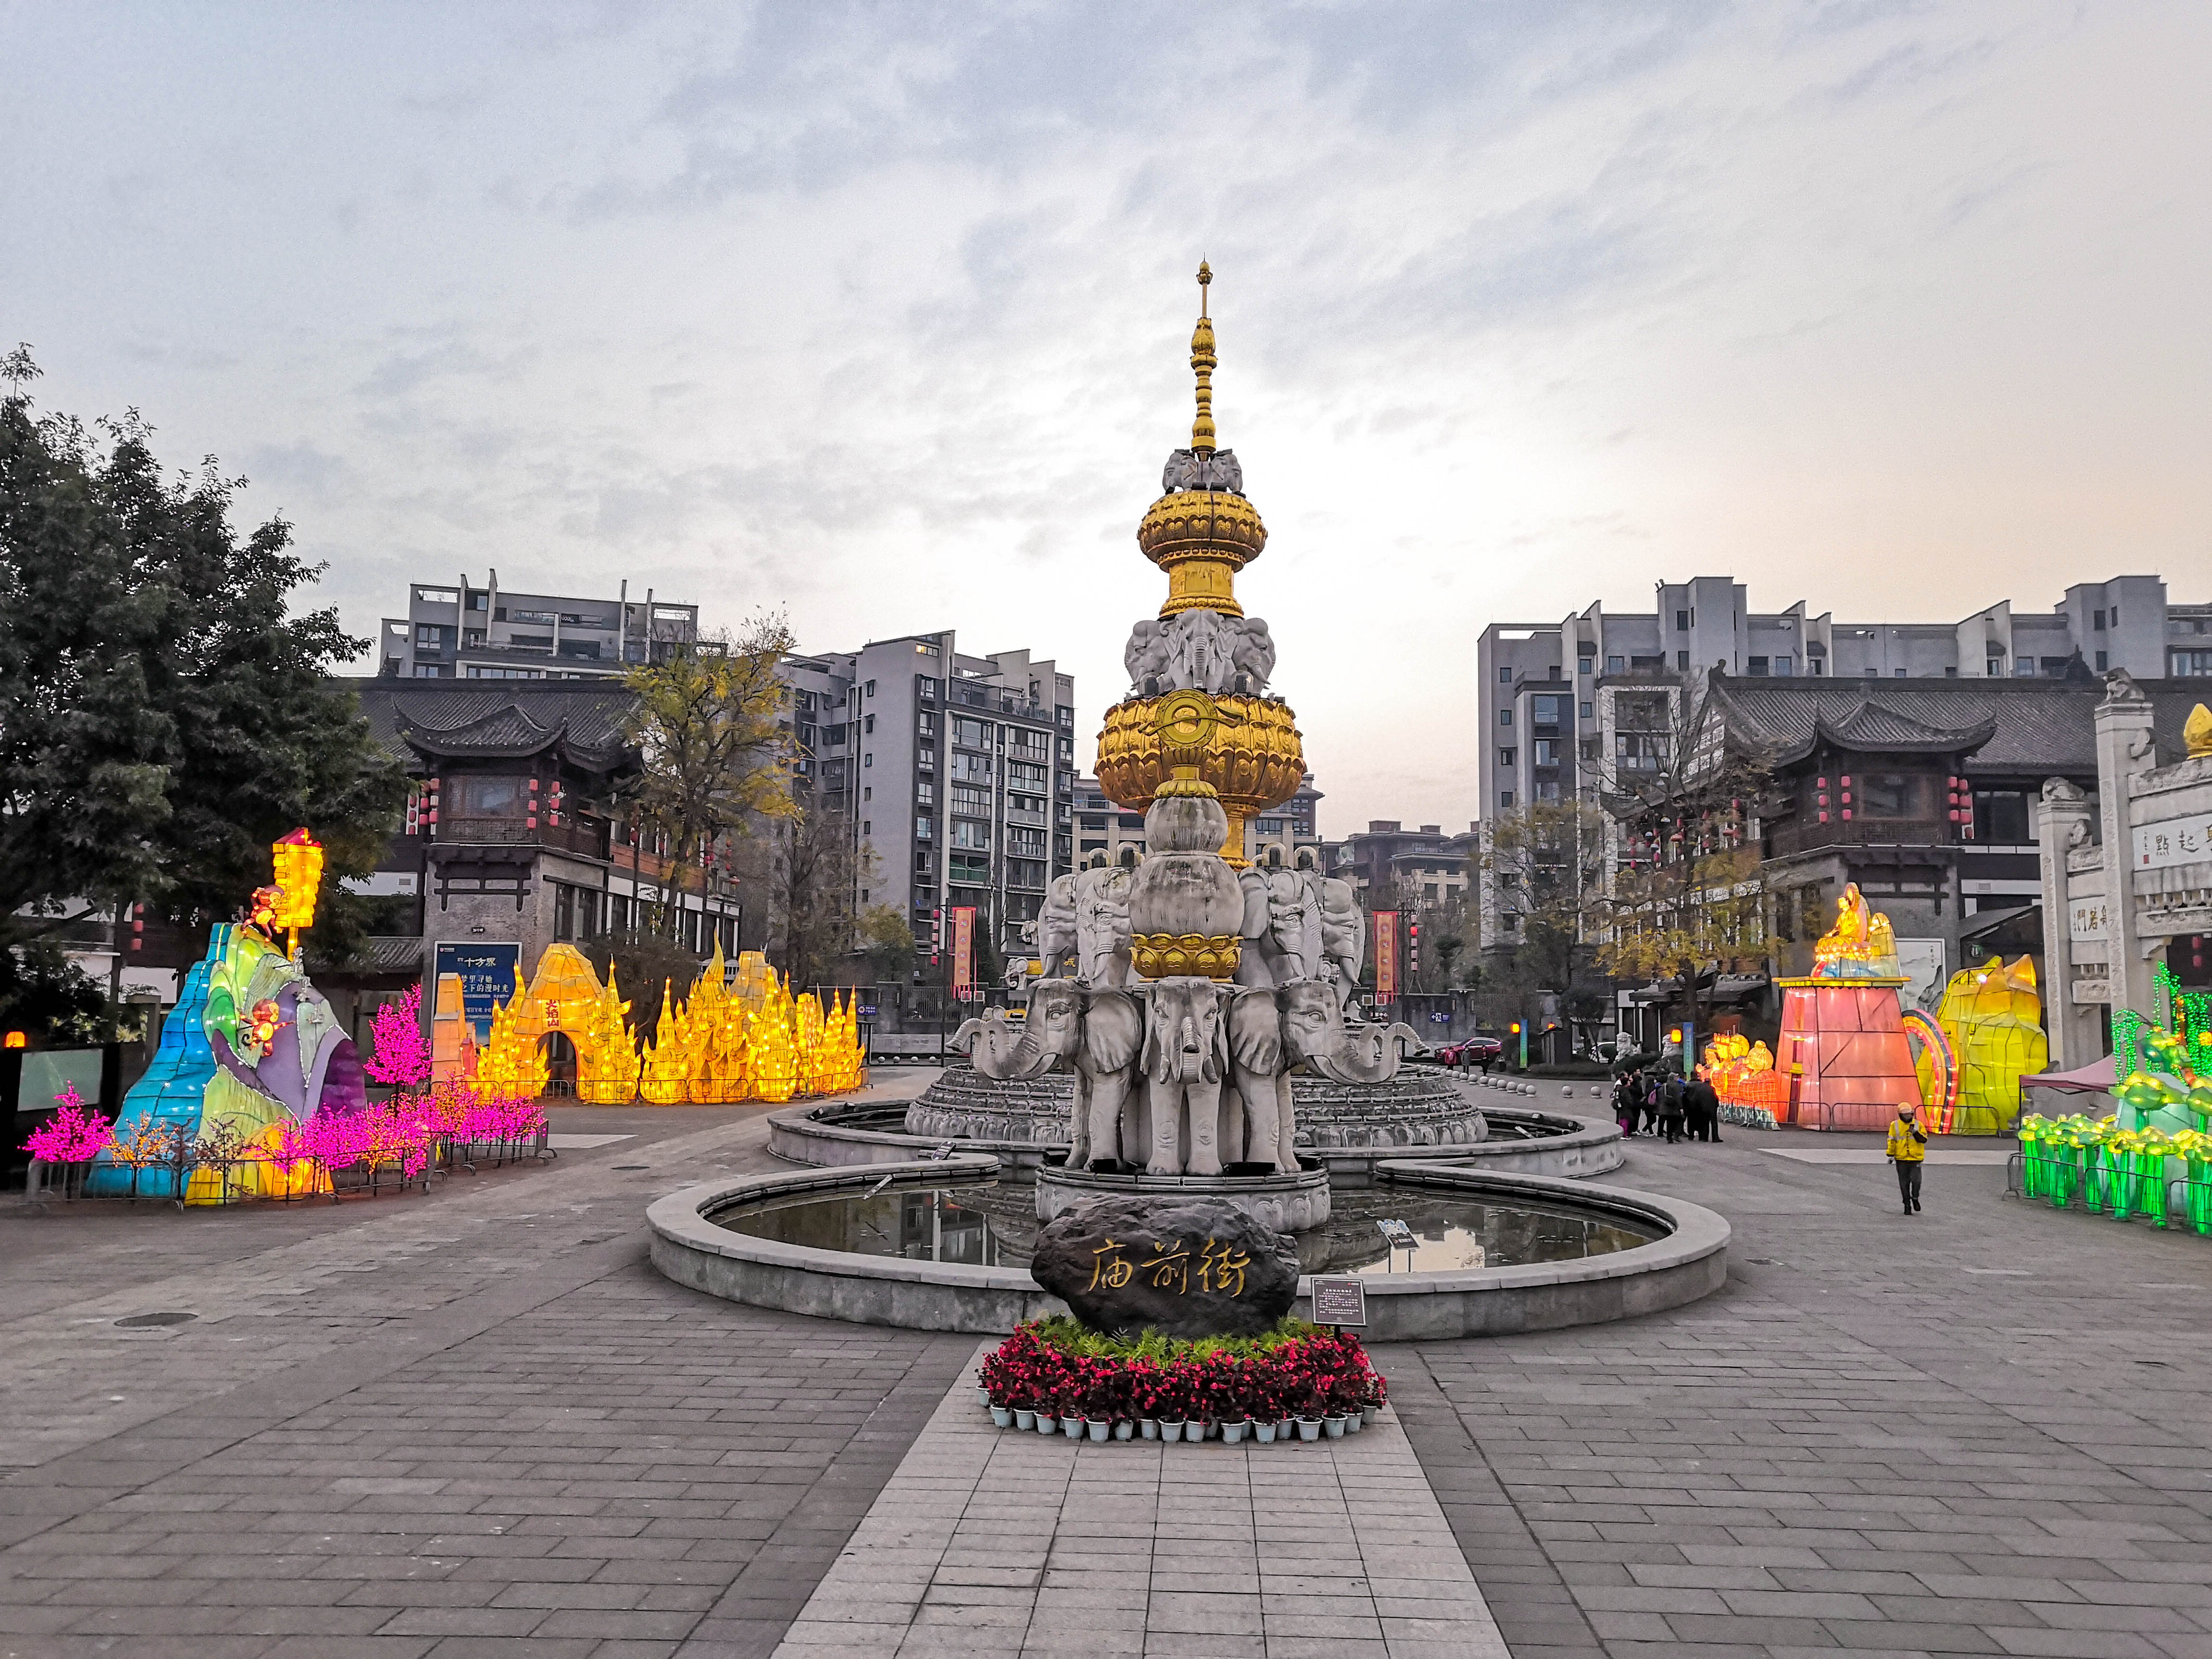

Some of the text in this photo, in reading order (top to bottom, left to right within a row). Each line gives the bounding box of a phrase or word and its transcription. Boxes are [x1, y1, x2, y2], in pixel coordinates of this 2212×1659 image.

[545, 999, 559, 1027] 火焰山
[1088, 1238, 1251, 1299] 庙前街
